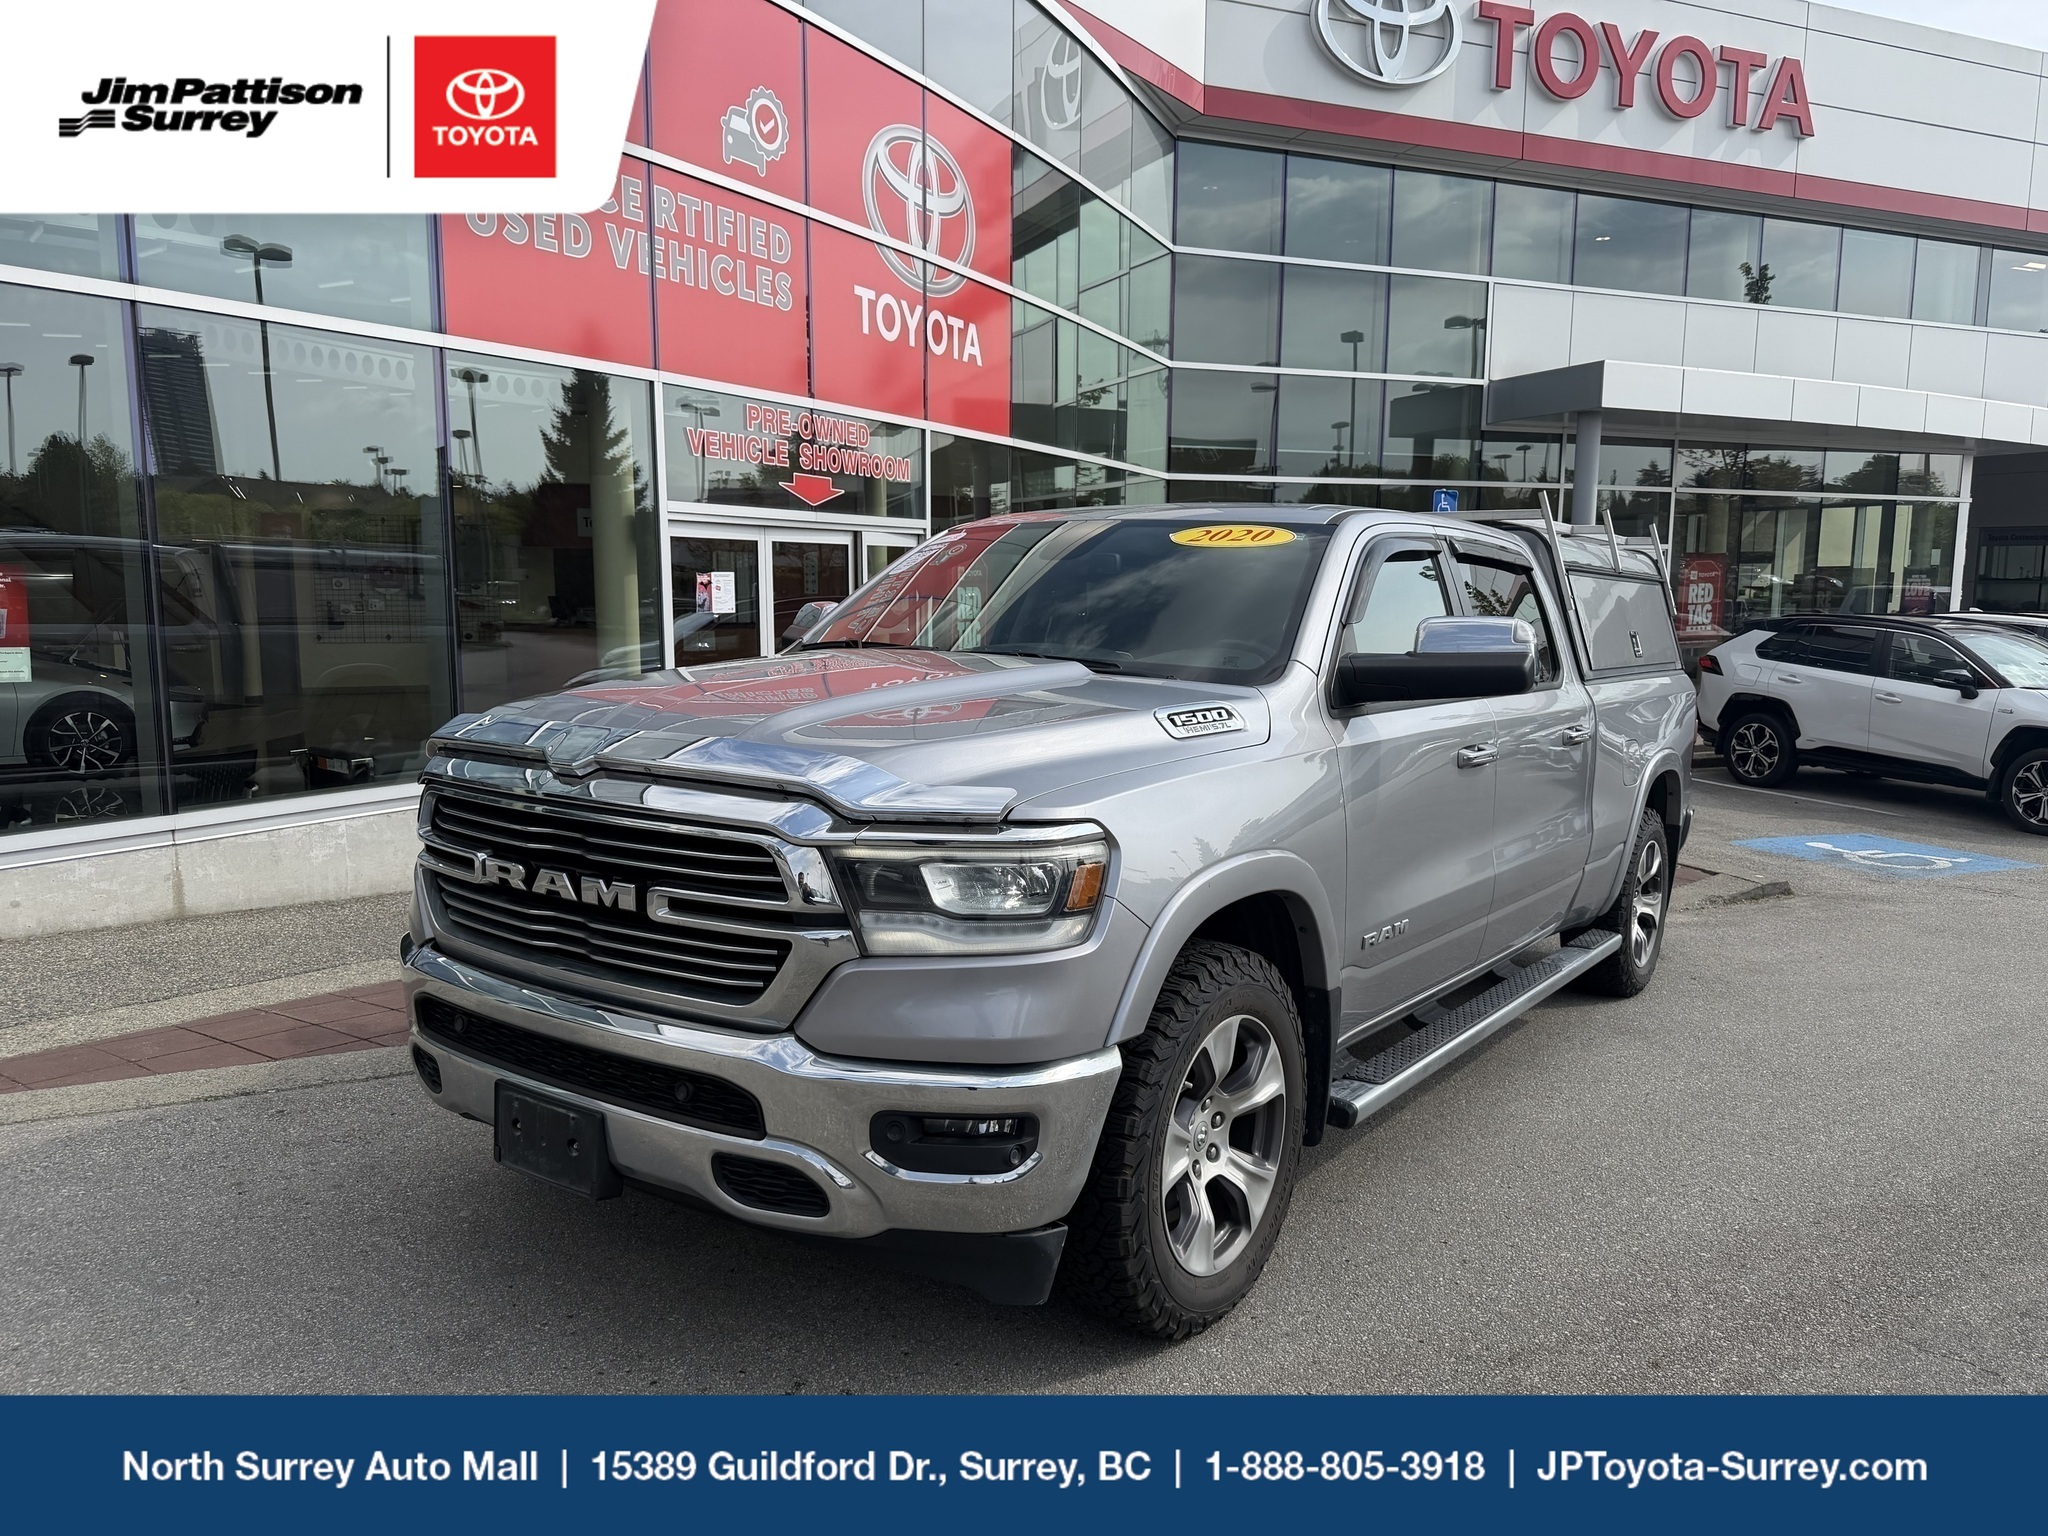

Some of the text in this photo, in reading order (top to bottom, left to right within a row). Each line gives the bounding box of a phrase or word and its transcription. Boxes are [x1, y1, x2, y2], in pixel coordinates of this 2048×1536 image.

[1473, 0, 1815, 139] TOYOTA
[605, 222, 793, 312] VEHICLES
[853, 284, 983, 367] TOYOTA
[746, 403, 870, 448] PRE-OWNED
[686, 426, 911, 482] VEHICLE SHOWROOM
[1185, 529, 1275, 542] 2020
[1688, 582, 1714, 604] RED
[1905, 582, 1931, 597] LOVE
[1687, 603, 1713, 625] TAG
[1169, 708, 1229, 727] 1500
[1185, 720, 1232, 735] HEMI 5.7L
[485, 856, 637, 912] RAM
[1360, 917, 1410, 951] RAM
